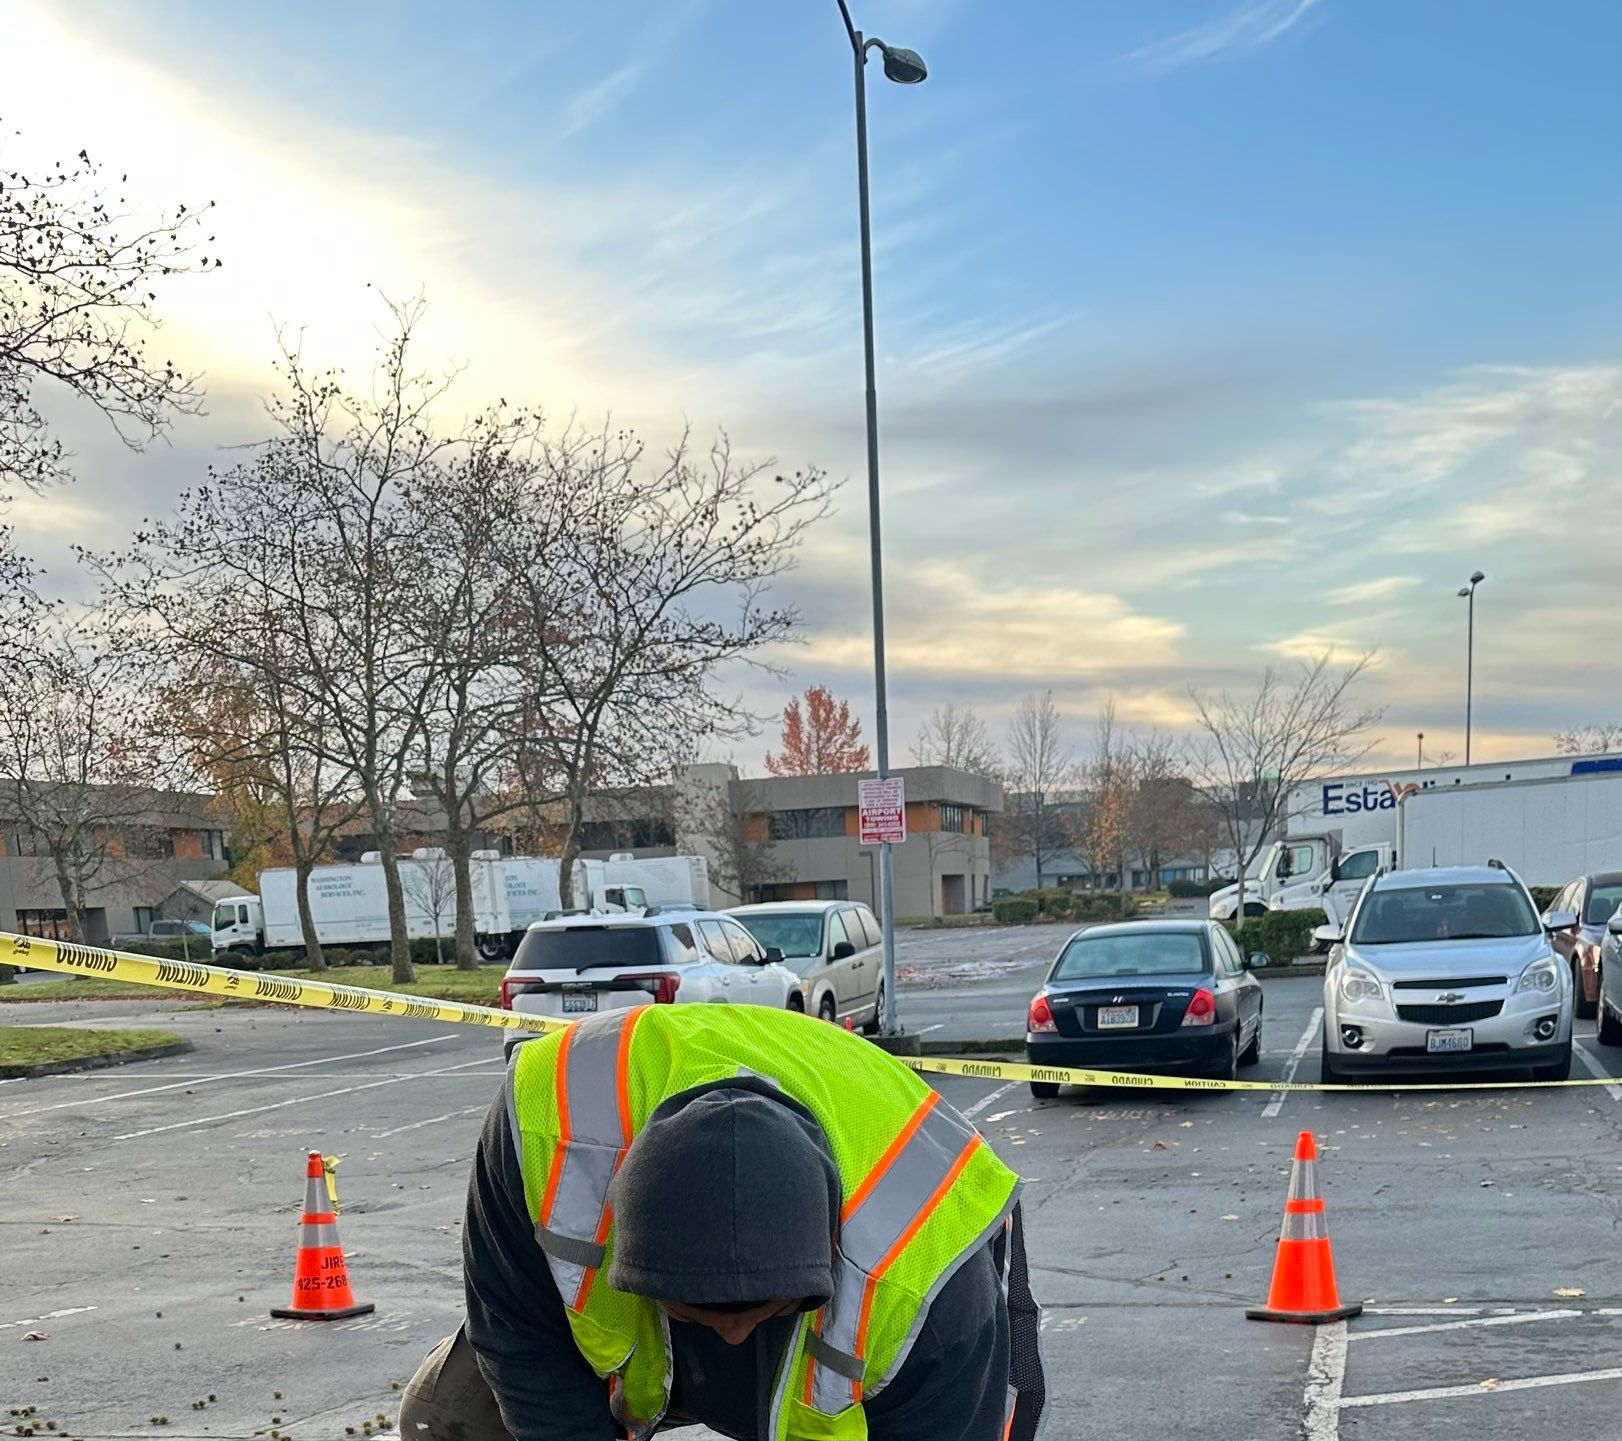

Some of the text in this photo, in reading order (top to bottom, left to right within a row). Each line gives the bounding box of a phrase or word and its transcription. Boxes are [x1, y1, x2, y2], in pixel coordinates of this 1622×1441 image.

[862, 807, 901, 817] AIRPORT
[56, 943, 118, 972] CUIDADO
[155, 959, 210, 987] CAUTION
